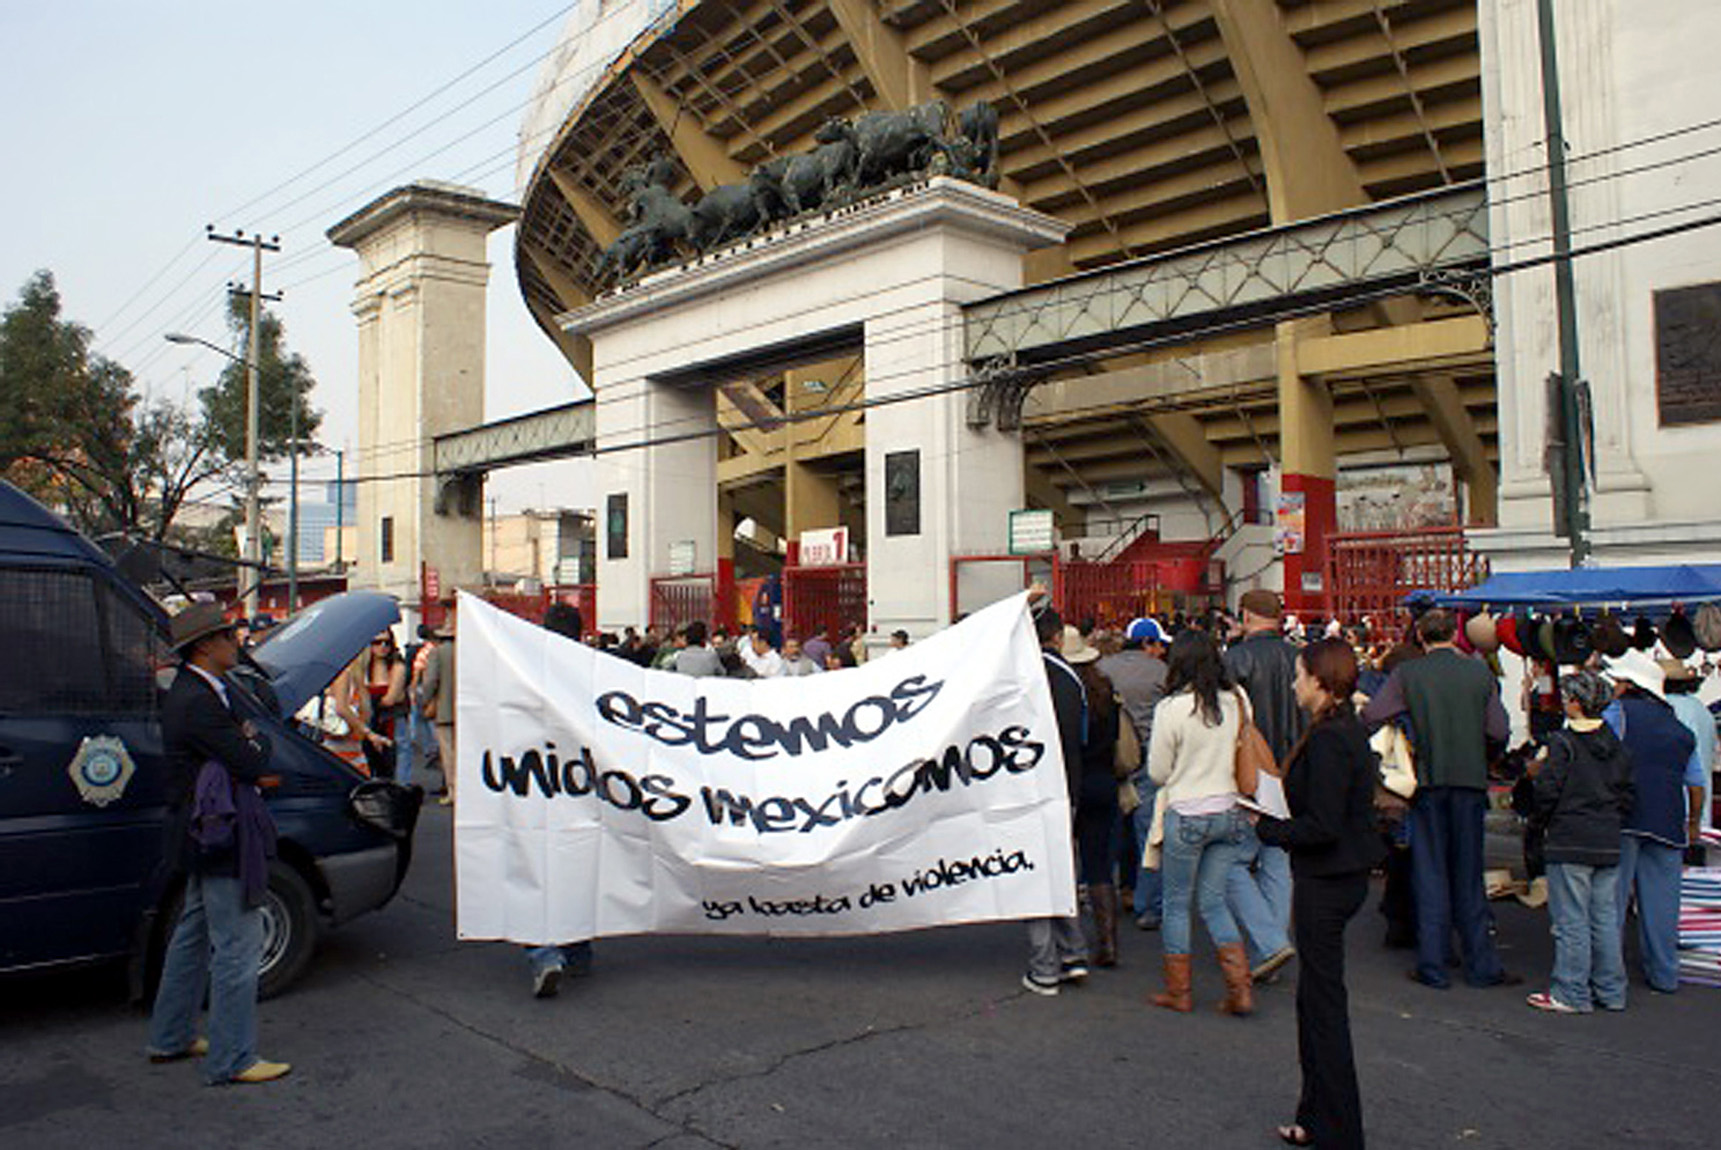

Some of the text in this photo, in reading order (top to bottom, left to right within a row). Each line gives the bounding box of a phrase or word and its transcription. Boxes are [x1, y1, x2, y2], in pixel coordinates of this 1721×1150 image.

[832, 530, 845, 562] 1
[595, 673, 944, 760] estemos
[482, 724, 1045, 833] unidos mexicanos
[702, 848, 1035, 920] ya basta de violencia.
